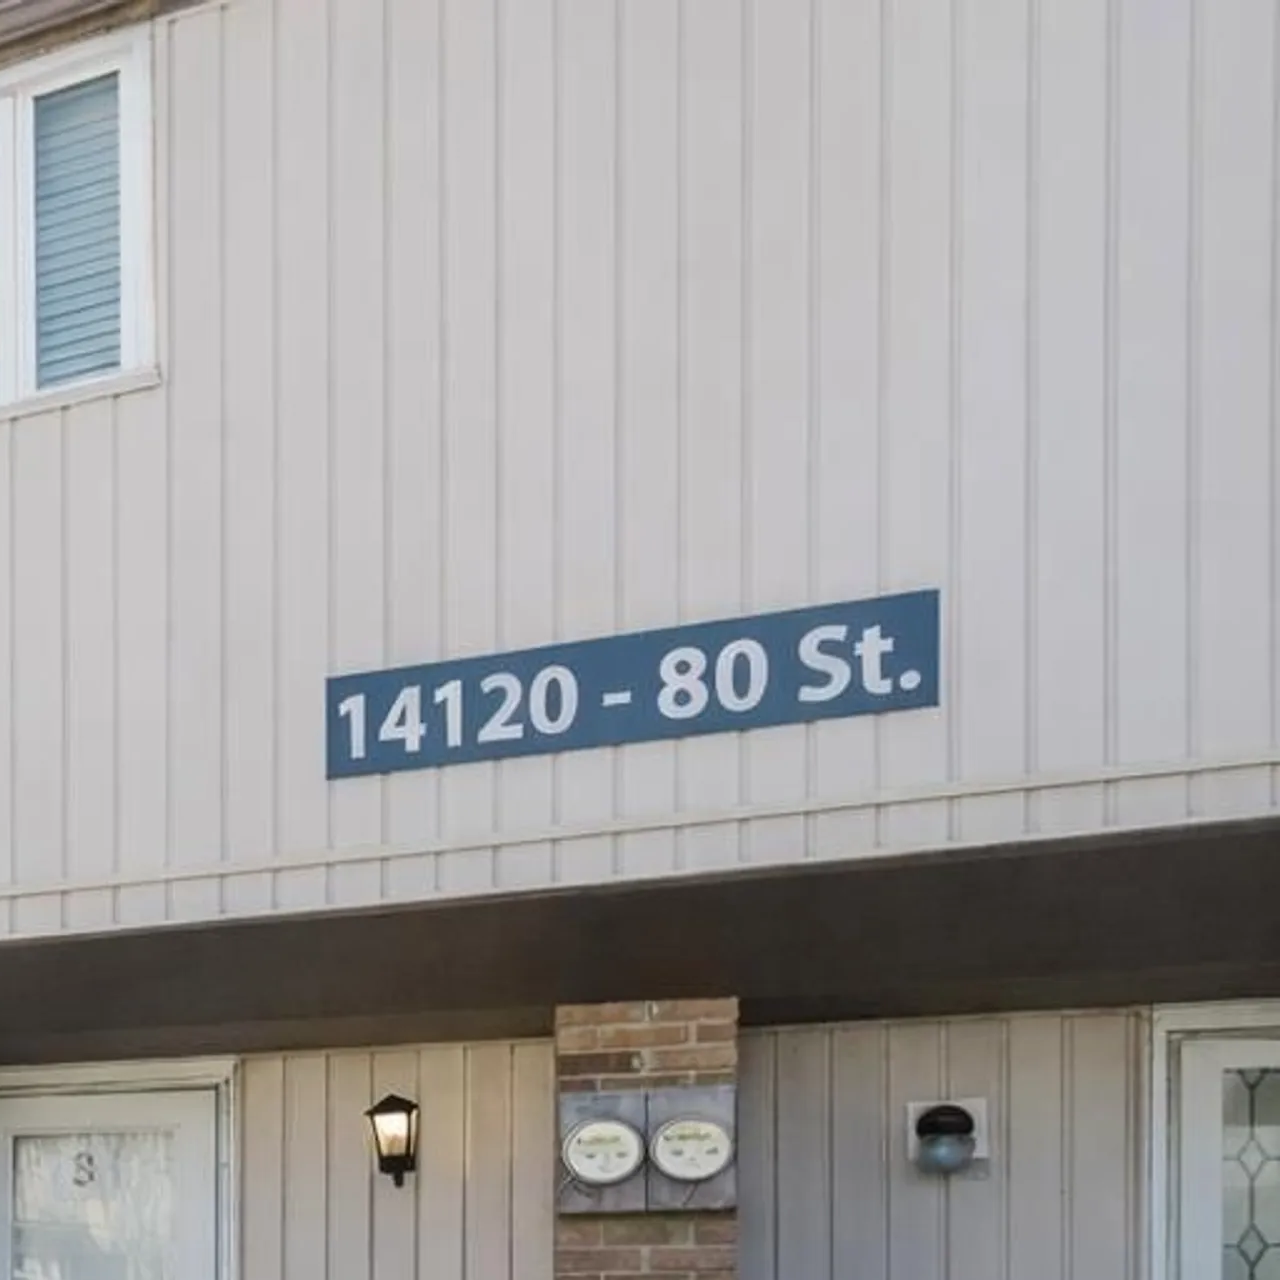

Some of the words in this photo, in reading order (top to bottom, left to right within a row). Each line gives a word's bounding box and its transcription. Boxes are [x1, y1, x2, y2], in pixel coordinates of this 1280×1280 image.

[337, 663, 579, 759] 14120
[601, 689, 633, 706] -
[656, 637, 769, 720] 80
[796, 624, 922, 702] St.
